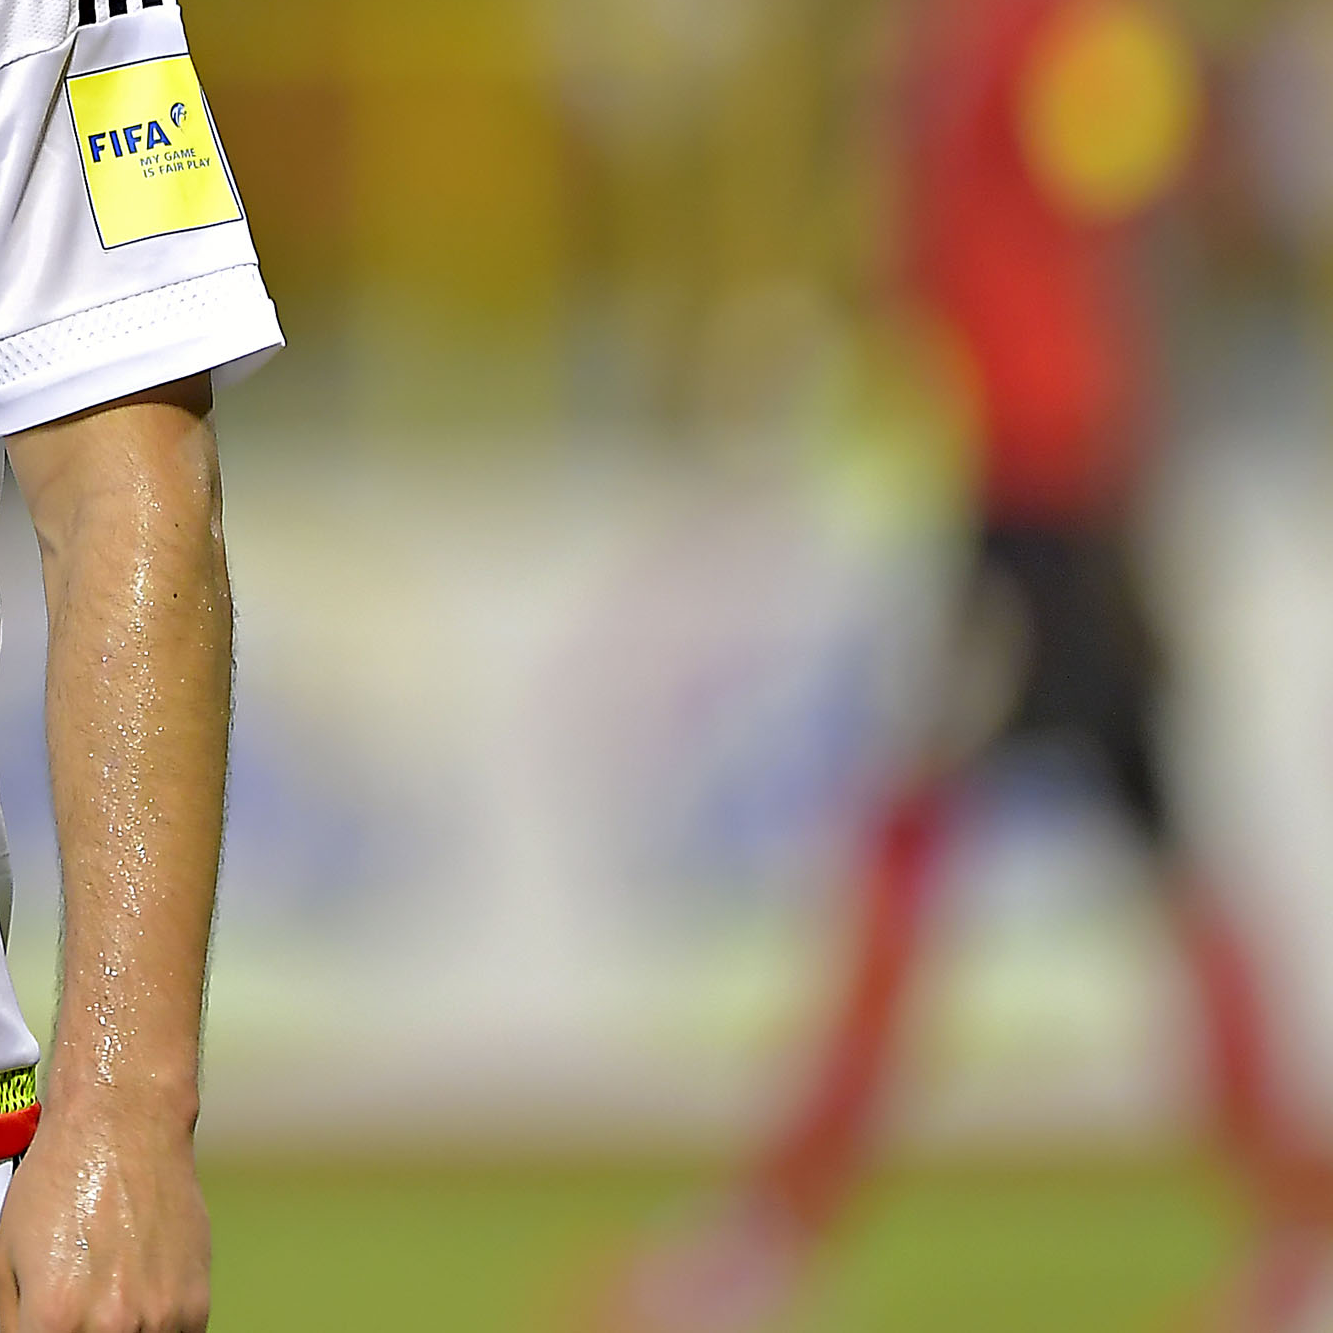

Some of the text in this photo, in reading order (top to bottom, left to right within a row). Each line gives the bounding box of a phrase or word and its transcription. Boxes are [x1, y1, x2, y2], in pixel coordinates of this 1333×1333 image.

[88, 120, 172, 163] FIFA
[140, 148, 196, 167] MY GAME
[143, 158, 210, 178] IS FAIR PLAY
